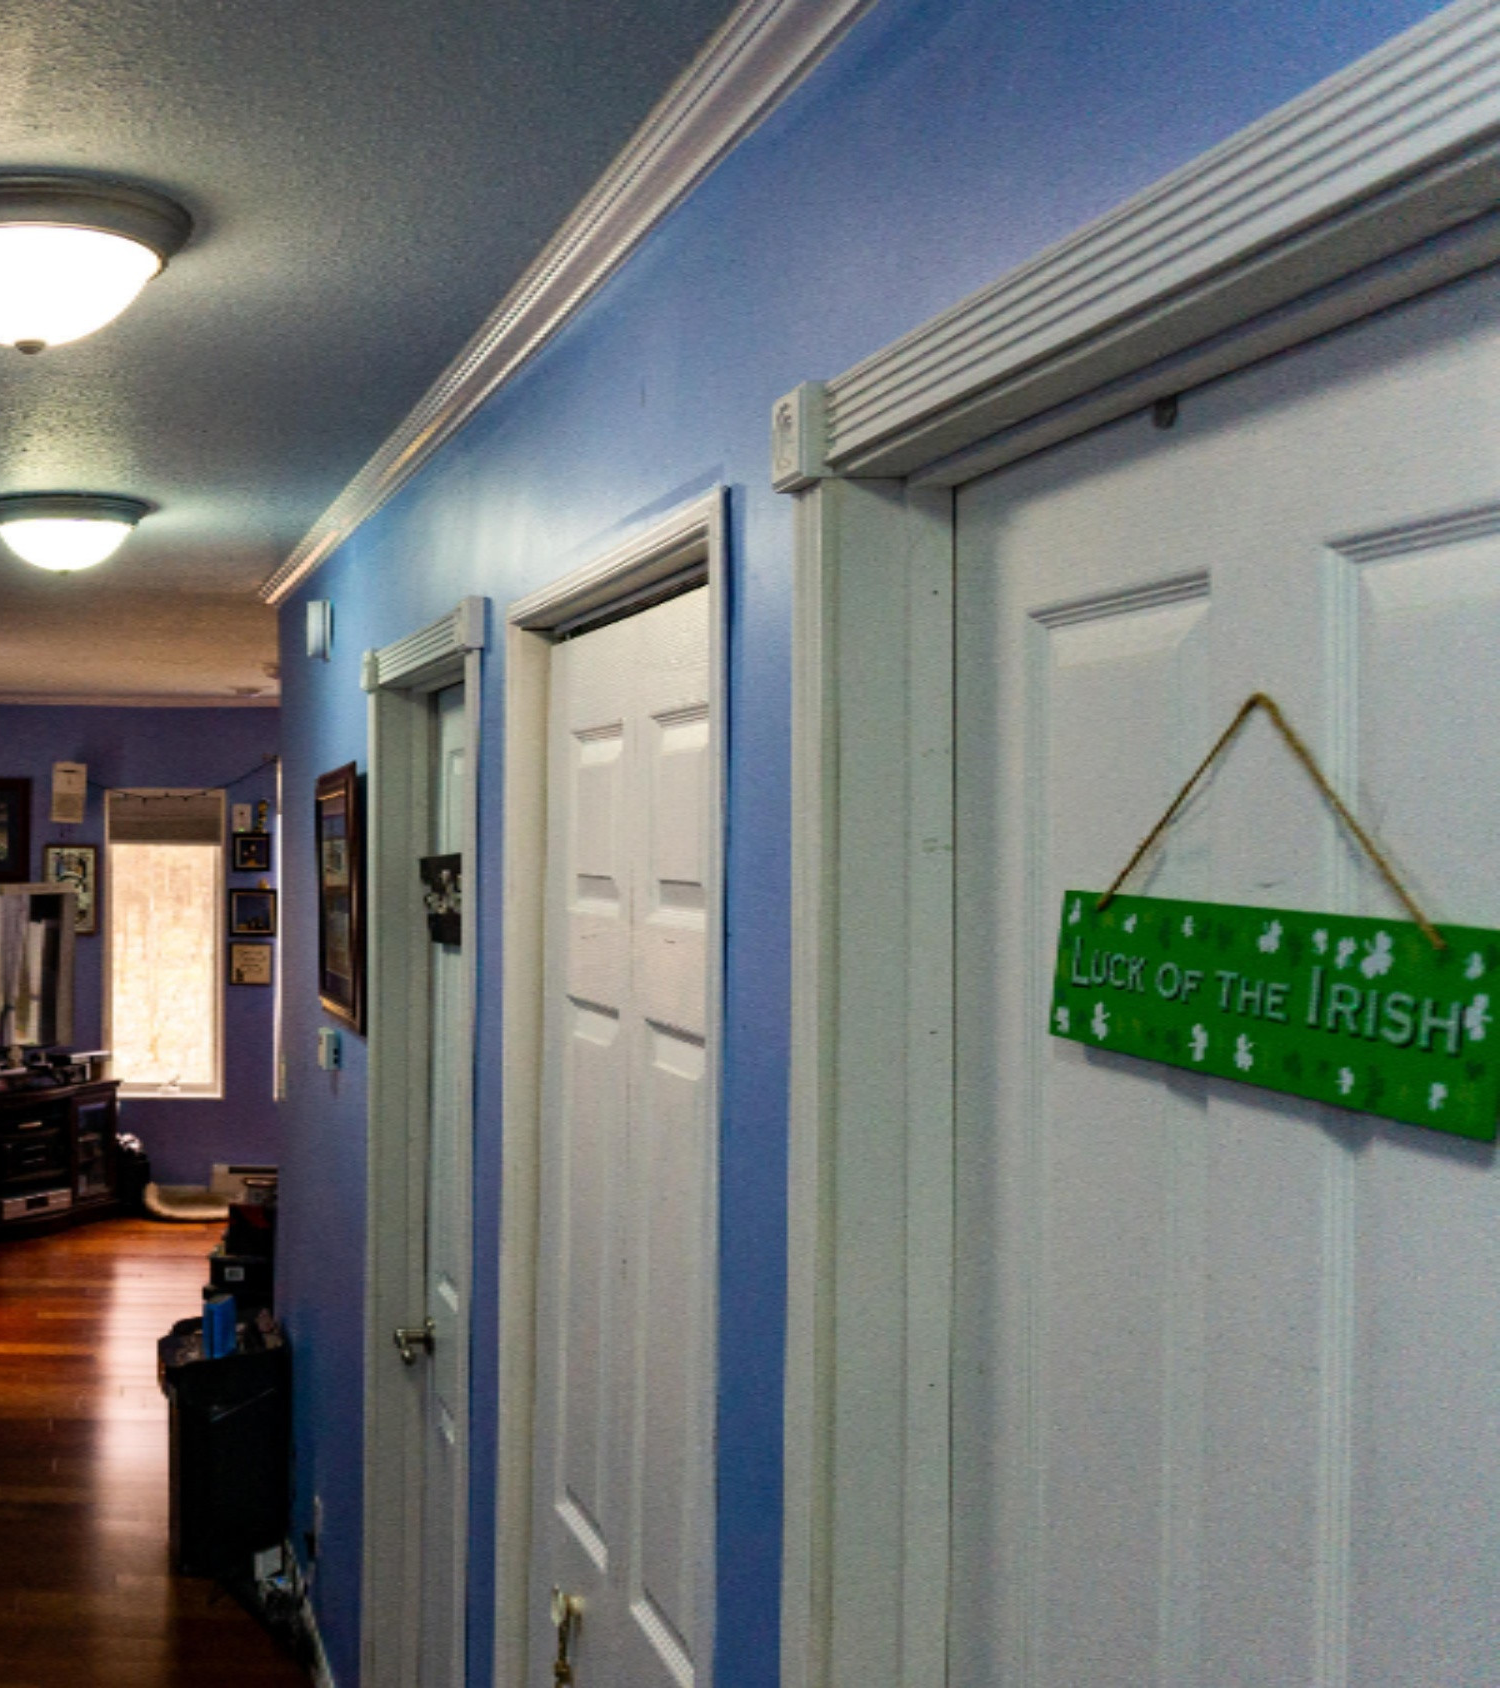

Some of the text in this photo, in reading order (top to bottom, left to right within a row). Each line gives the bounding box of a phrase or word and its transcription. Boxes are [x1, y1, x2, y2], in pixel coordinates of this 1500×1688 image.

[1071, 935, 1463, 1055] LUCK OF THE IRISH
